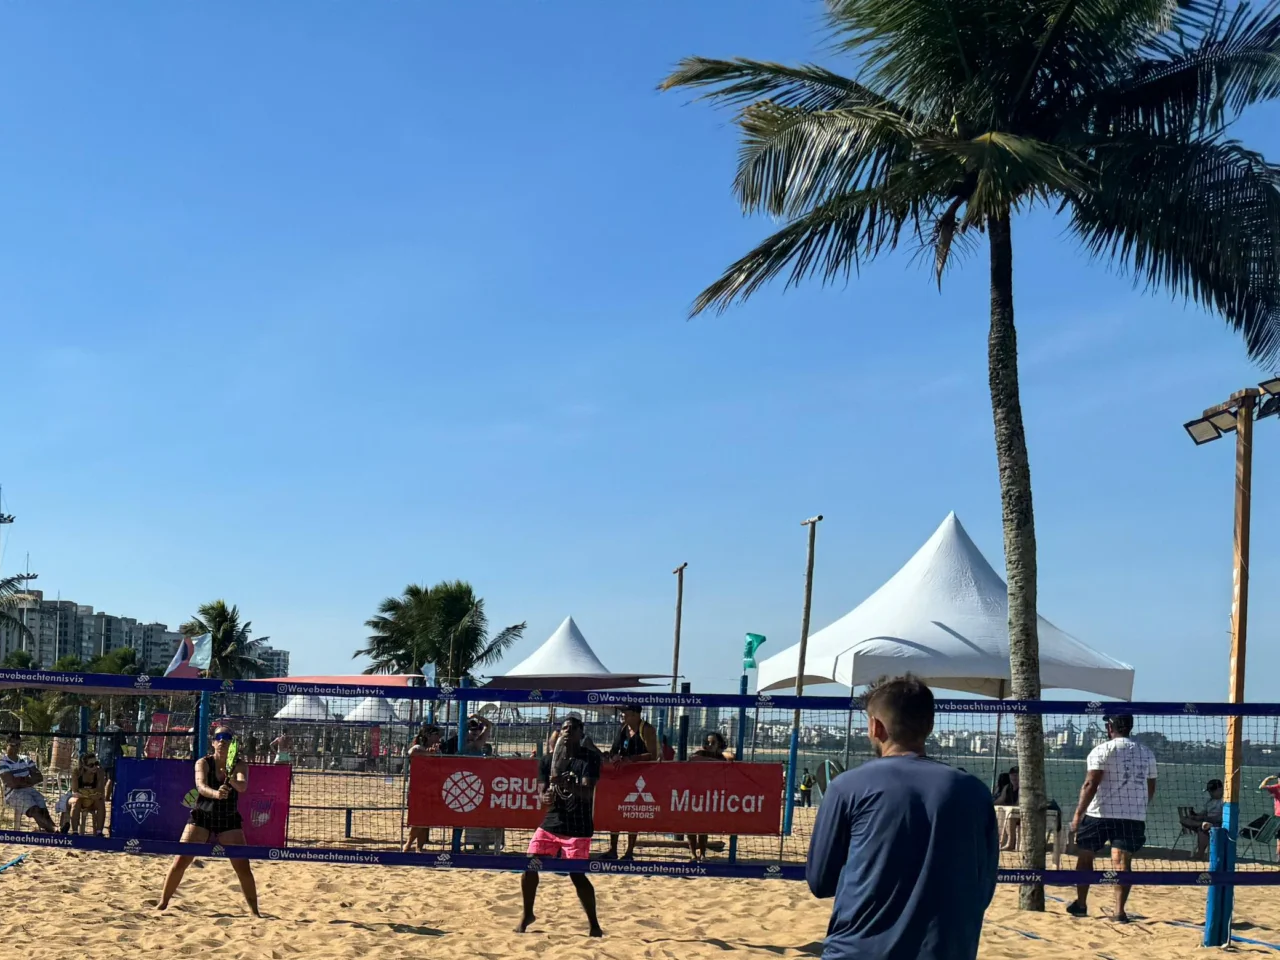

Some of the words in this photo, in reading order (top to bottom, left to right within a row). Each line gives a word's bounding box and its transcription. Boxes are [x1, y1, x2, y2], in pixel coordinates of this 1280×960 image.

[288, 684, 385, 695] Wavebeachtennisvix
[599, 693, 702, 705] Wavebeachtennisvix
[491, 776, 541, 793] GRU
[670, 789, 765, 813] Multicar
[617, 804, 661, 812] MITSUBISHI
[280, 850, 380, 863] Wavebeachtennisvix
[601, 862, 707, 875] Wavebeachtennisvix
